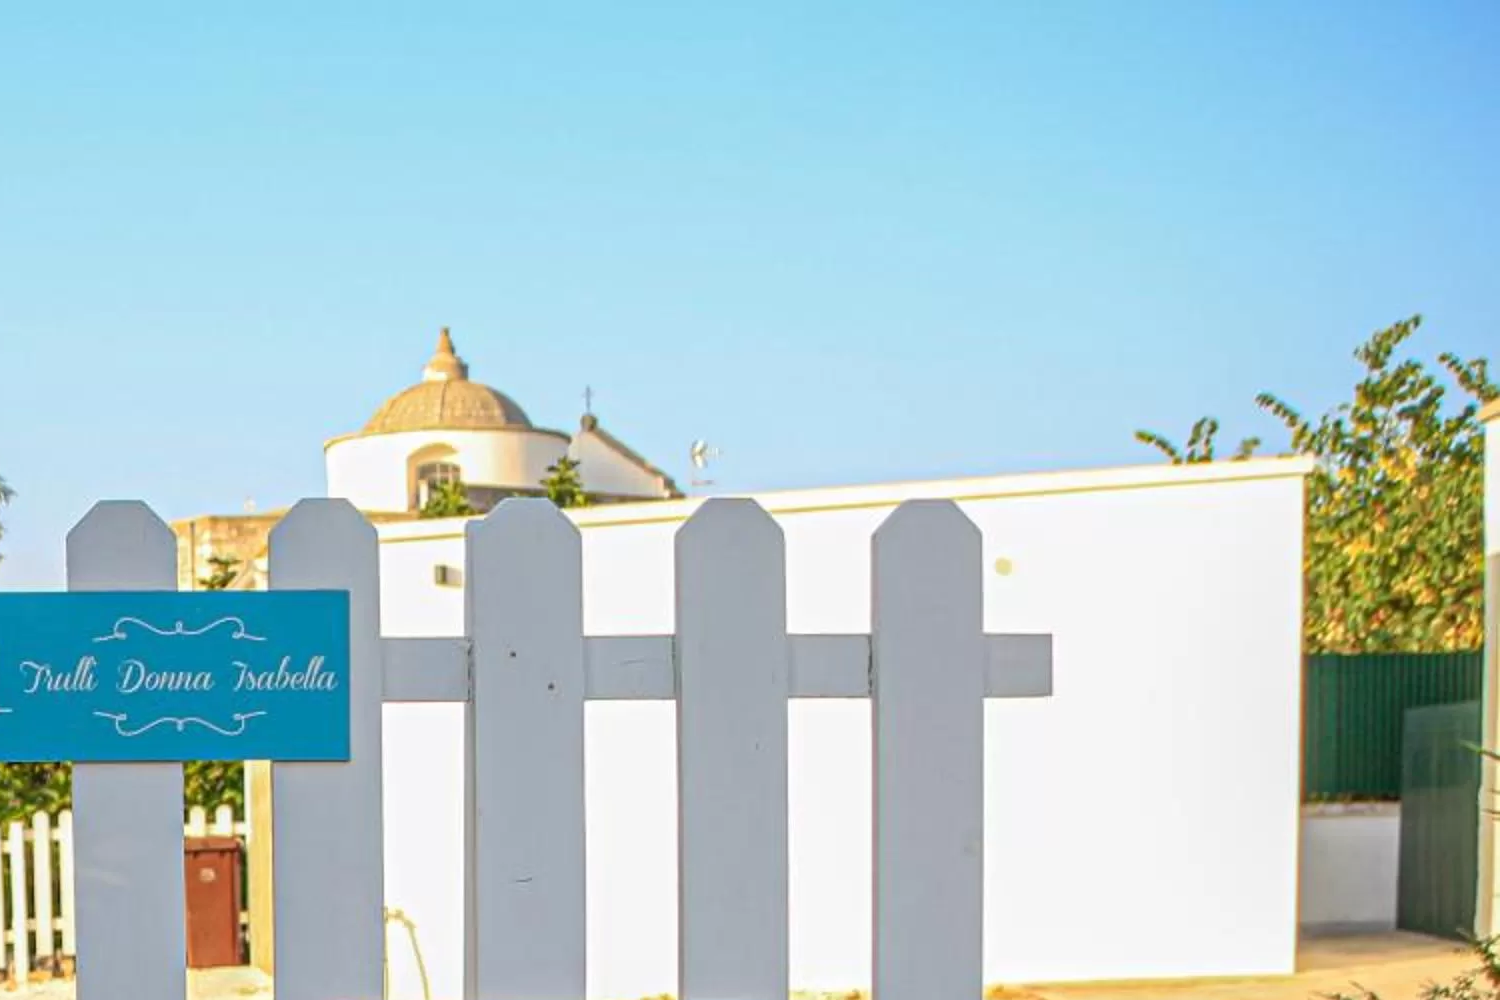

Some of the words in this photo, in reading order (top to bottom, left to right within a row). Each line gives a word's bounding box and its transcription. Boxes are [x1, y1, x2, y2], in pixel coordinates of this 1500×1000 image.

[19, 655, 98, 693] Trulli
[116, 658, 214, 693] Donna
[232, 655, 338, 692] Isabella
